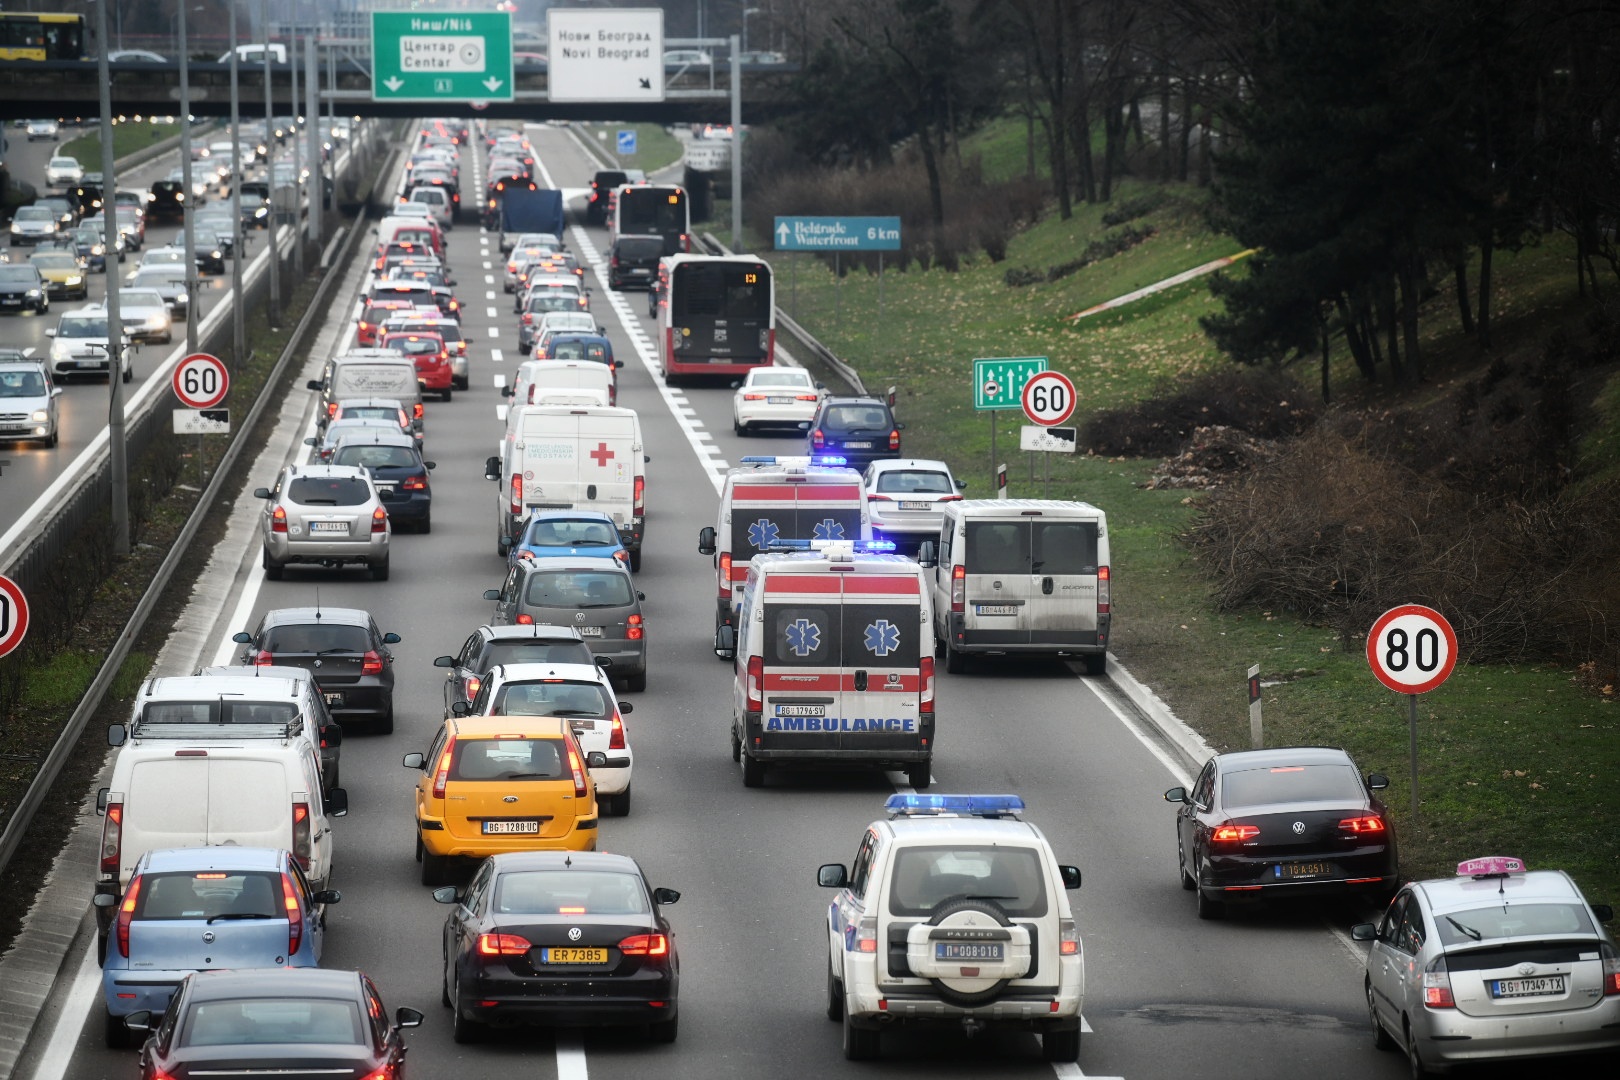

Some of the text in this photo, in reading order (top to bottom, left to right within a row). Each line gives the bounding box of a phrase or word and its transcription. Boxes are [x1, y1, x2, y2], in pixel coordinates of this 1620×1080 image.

[559, 29, 651, 43] Нови Београд
[404, 41, 455, 54] Центар
[562, 47, 649, 61] Novi Beograd
[404, 56, 450, 67] Centar
[794, 221, 846, 236] Belgrade
[867, 227, 899, 240] 6 km
[794, 233, 859, 246] Waterfront
[185, 368, 216, 394] 60
[1033, 385, 1064, 412] 60
[1386, 628, 1438, 672] 80
[781, 706, 791, 715] BG
[766, 717, 915, 732] AMBULANCE
[489, 823, 499, 832] BG
[553, 949, 601, 961] ER 7385
[1500, 981, 1514, 993] BG
